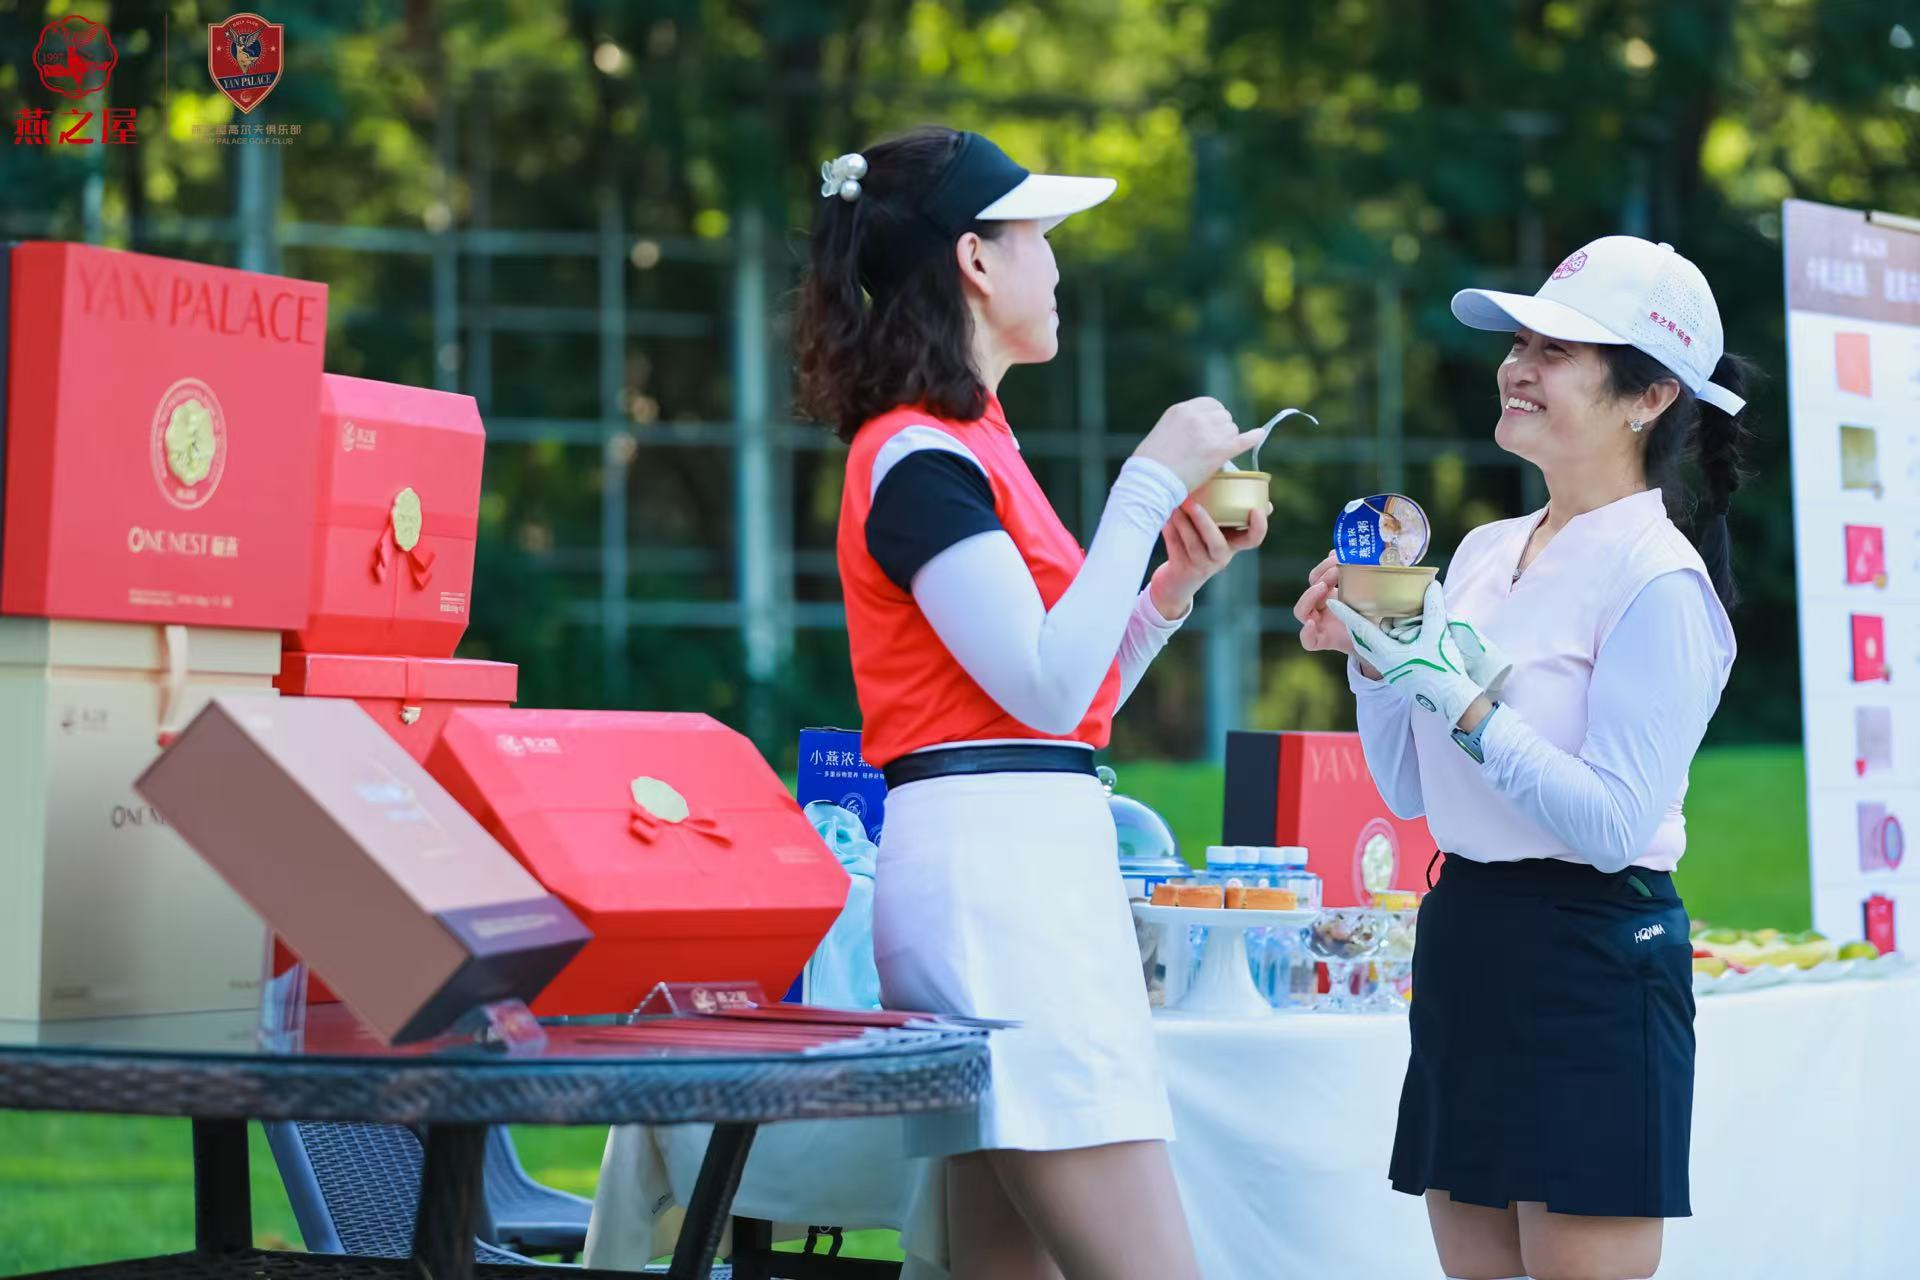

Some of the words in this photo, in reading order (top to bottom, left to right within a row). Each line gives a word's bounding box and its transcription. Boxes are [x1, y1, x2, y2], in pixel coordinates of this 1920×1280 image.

[77, 261, 157, 322] YAN
[169, 275, 318, 346] PALACE
[1357, 520, 1371, 558] 燕窝粥
[809, 749, 855, 767] 小燕浓
